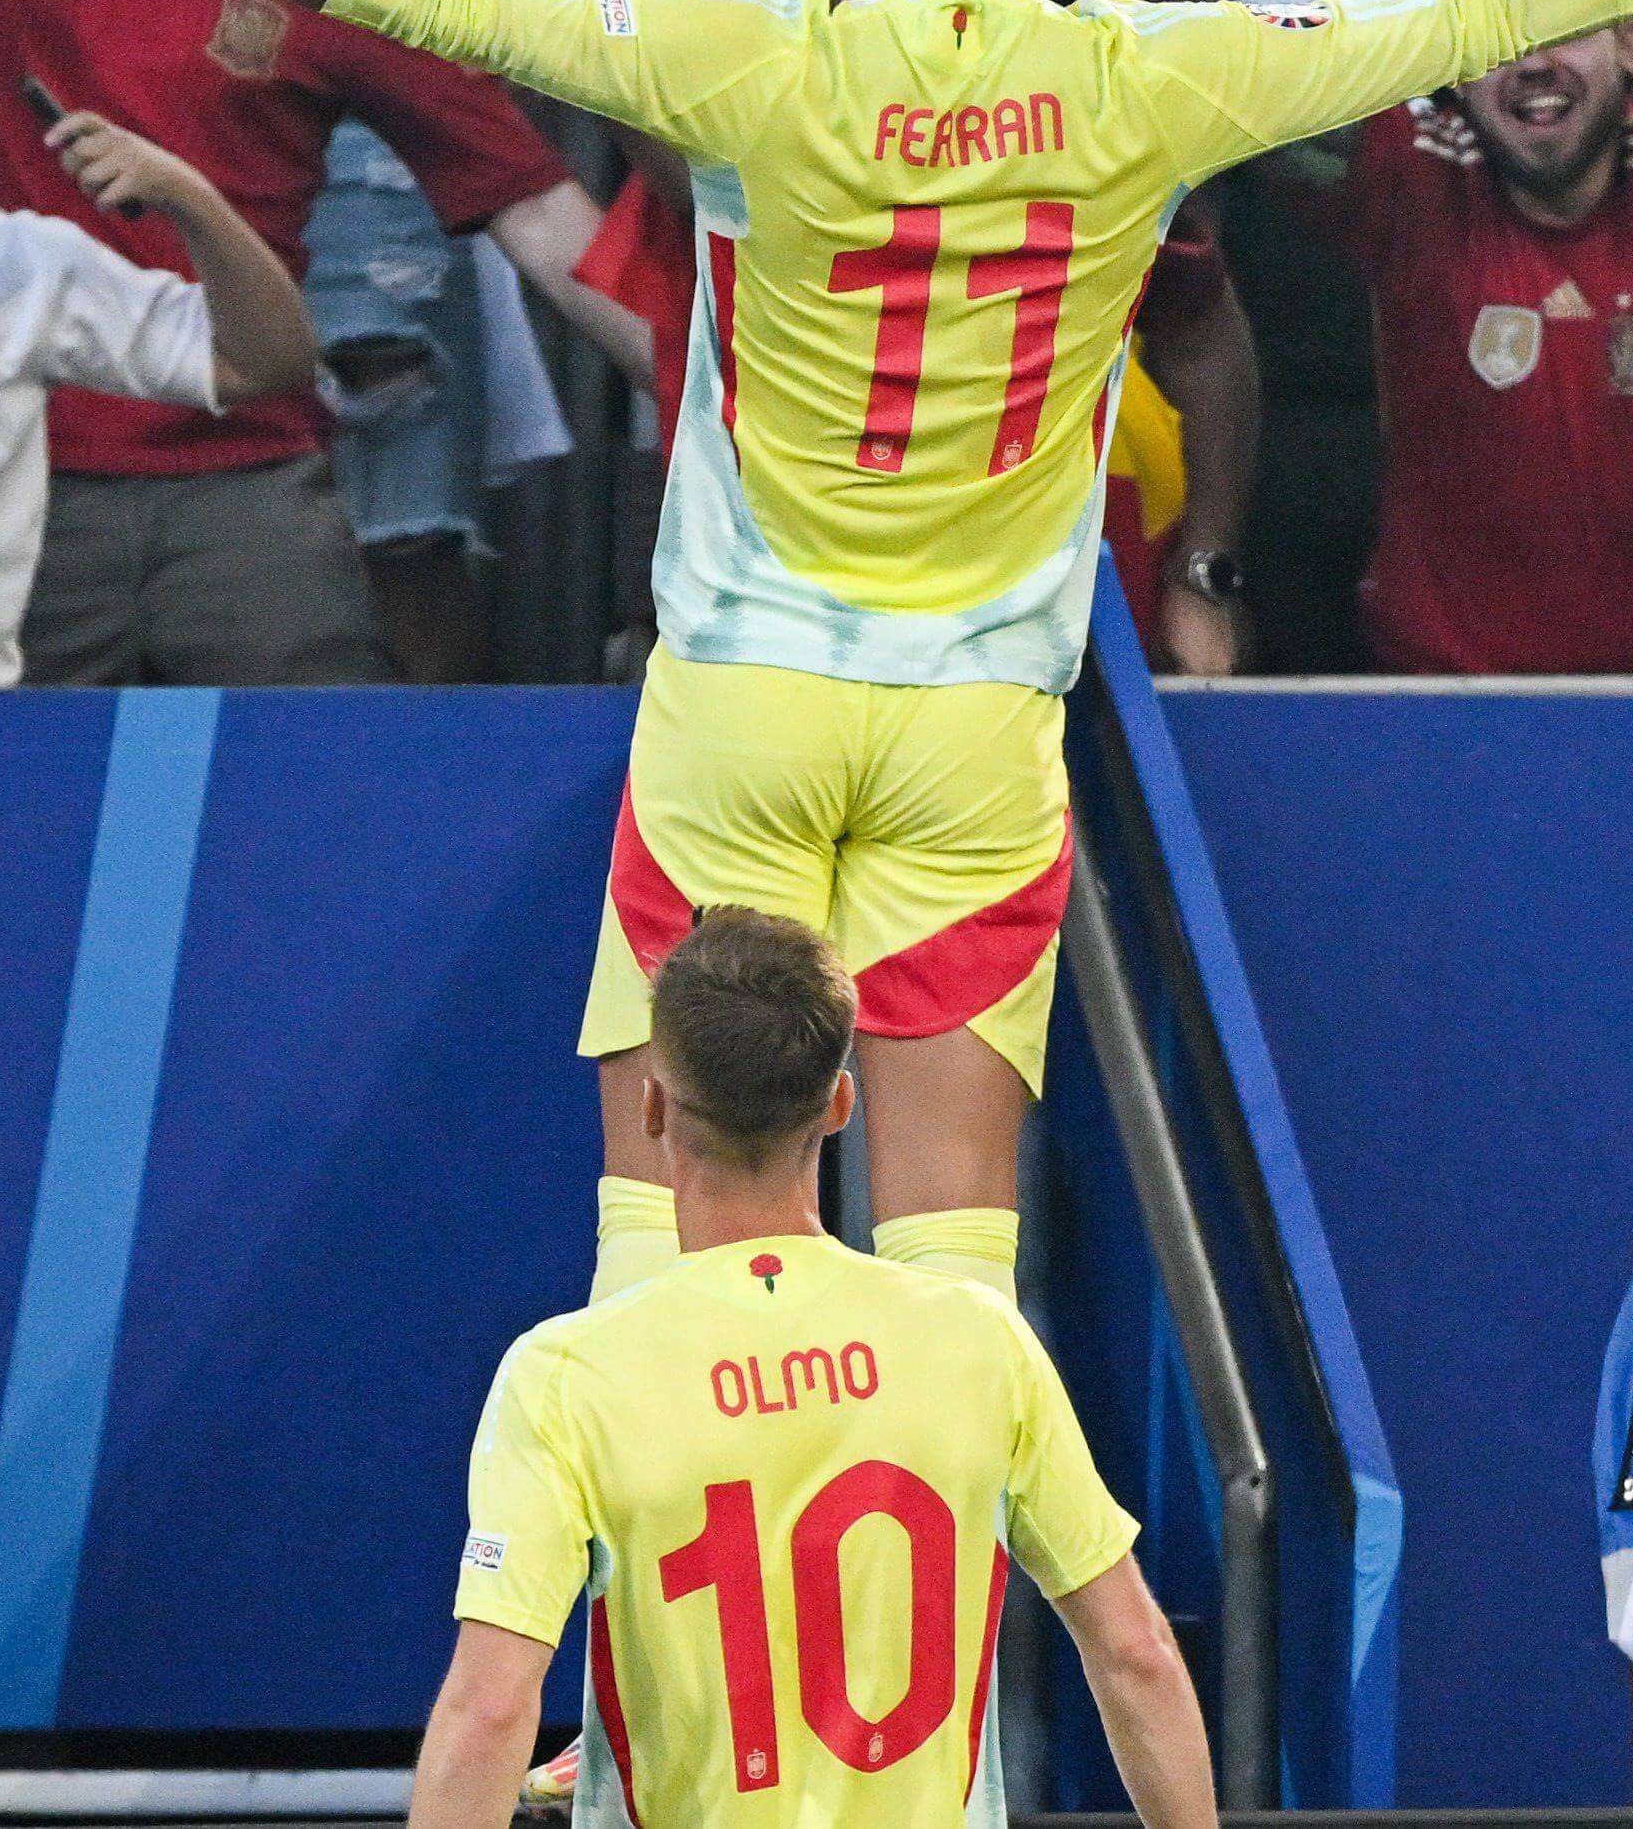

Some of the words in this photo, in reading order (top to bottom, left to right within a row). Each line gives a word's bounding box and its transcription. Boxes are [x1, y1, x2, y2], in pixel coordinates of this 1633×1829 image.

[874, 92, 1064, 168] FERRAN
[827, 201, 1076, 477] 11
[711, 1342, 880, 1417] OLMO
[659, 1459, 957, 1794] 10
